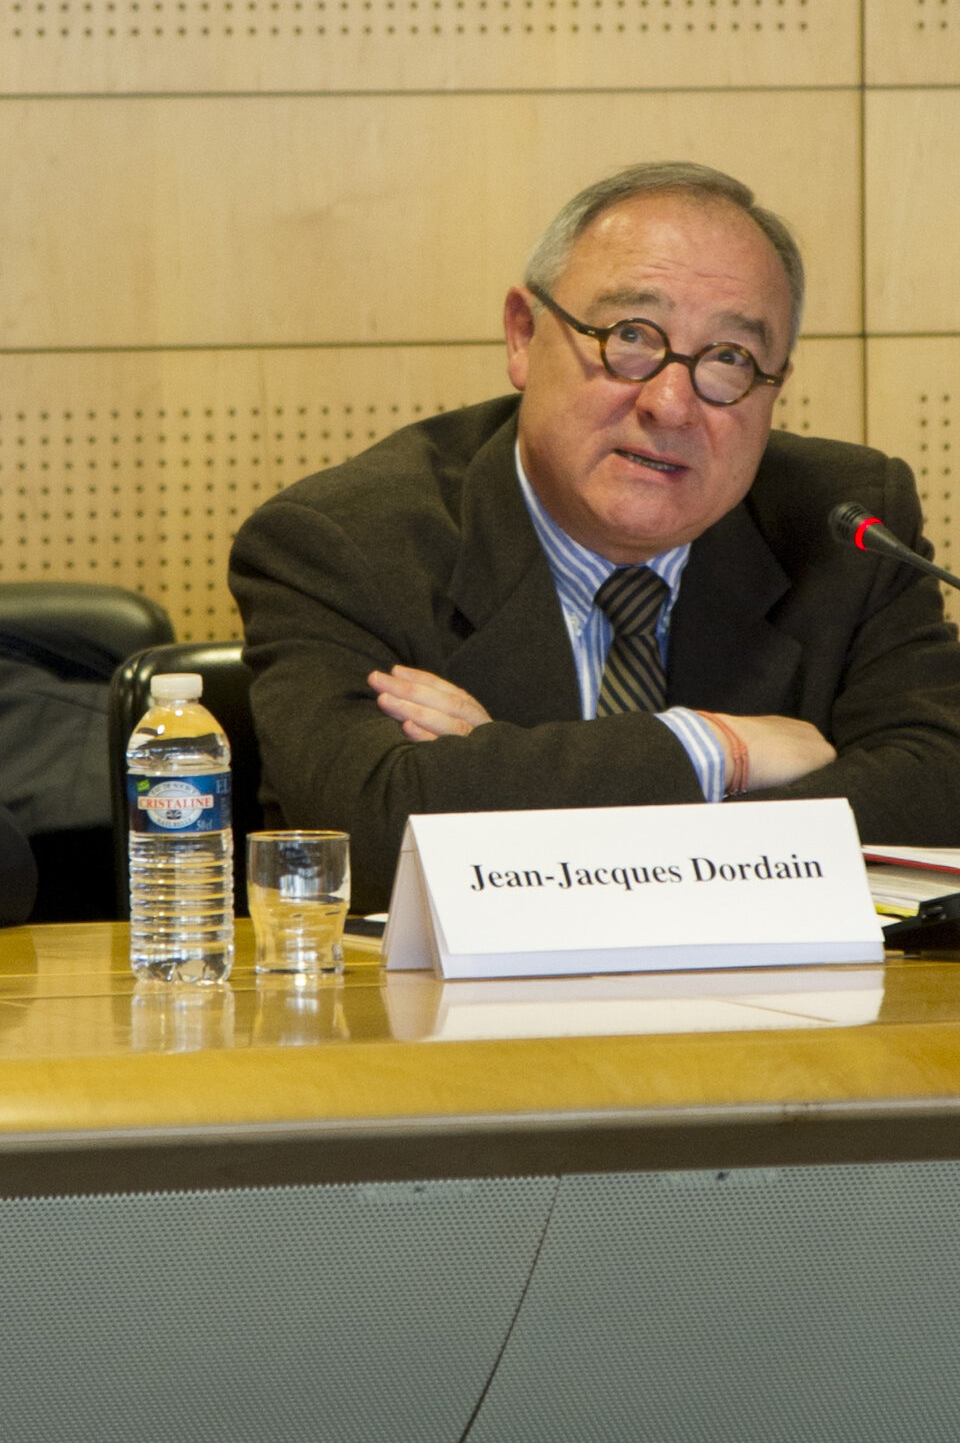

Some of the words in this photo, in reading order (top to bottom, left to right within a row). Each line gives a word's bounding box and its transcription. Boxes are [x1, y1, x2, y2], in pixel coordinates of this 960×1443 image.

[138, 797, 212, 808] CRISTALINE
[470, 861, 683, 891] Jean-Jacques
[689, 854, 824, 883] Dordain
